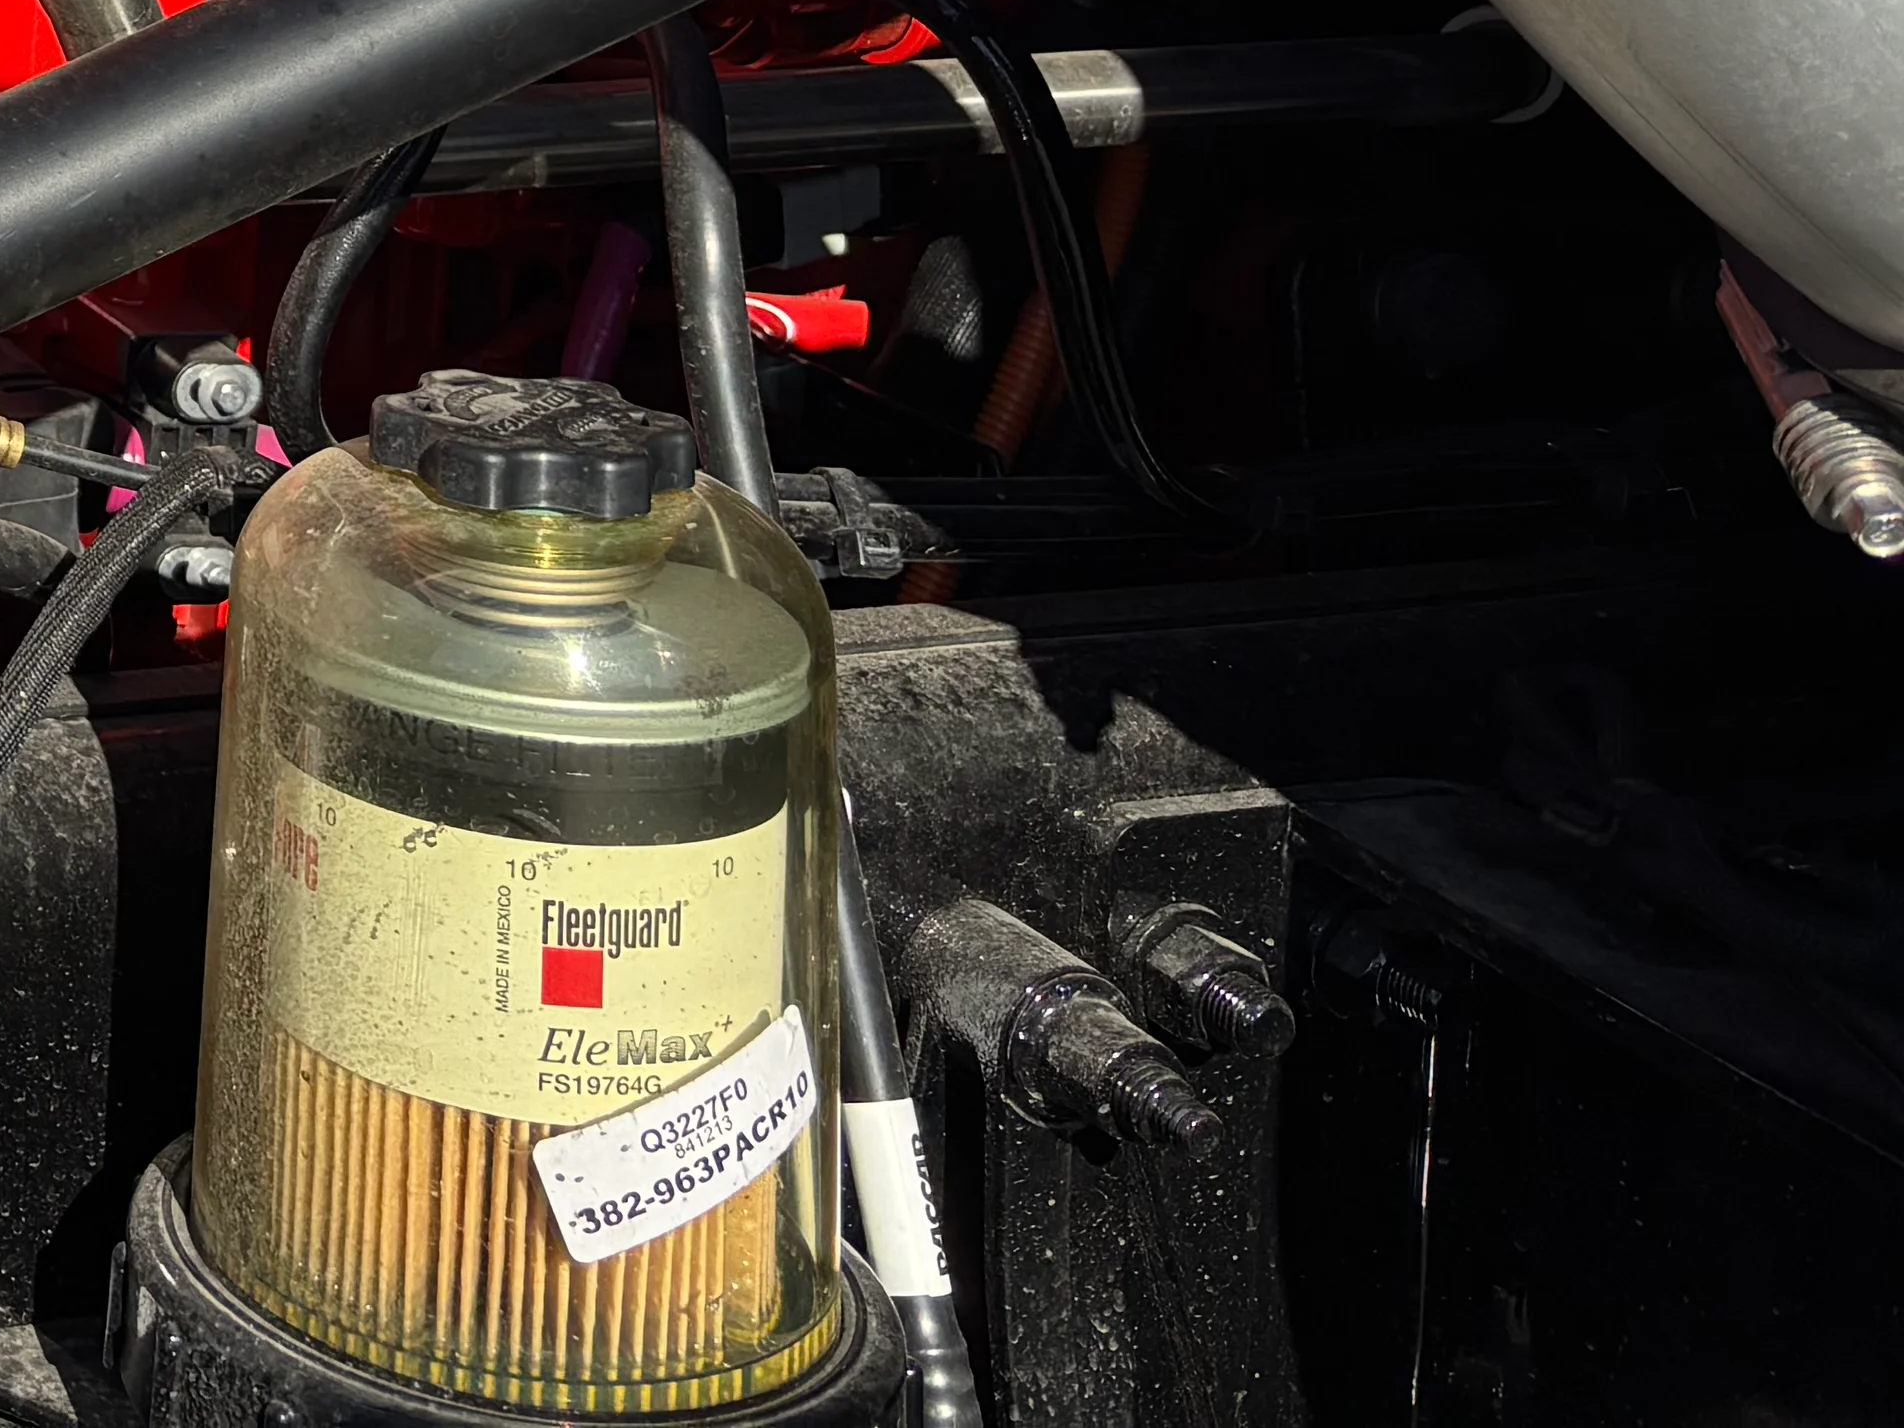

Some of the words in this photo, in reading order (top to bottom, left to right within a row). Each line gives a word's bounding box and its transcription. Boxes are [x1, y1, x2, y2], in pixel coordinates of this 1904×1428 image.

[316, 803, 337, 826] 10
[505, 859, 537, 882] 10
[711, 856, 735, 879] 10
[497, 885, 511, 945] MEXICO
[541, 900, 683, 960] Fleetguard
[496, 949, 510, 964] IN
[495, 967, 510, 1013] MADE
[538, 1073, 662, 1095] FS19764G
[640, 1078, 748, 1153] Q3227F0
[674, 1114, 734, 1159] 841213
[580, 1071, 809, 1234] 382-963PACR10
